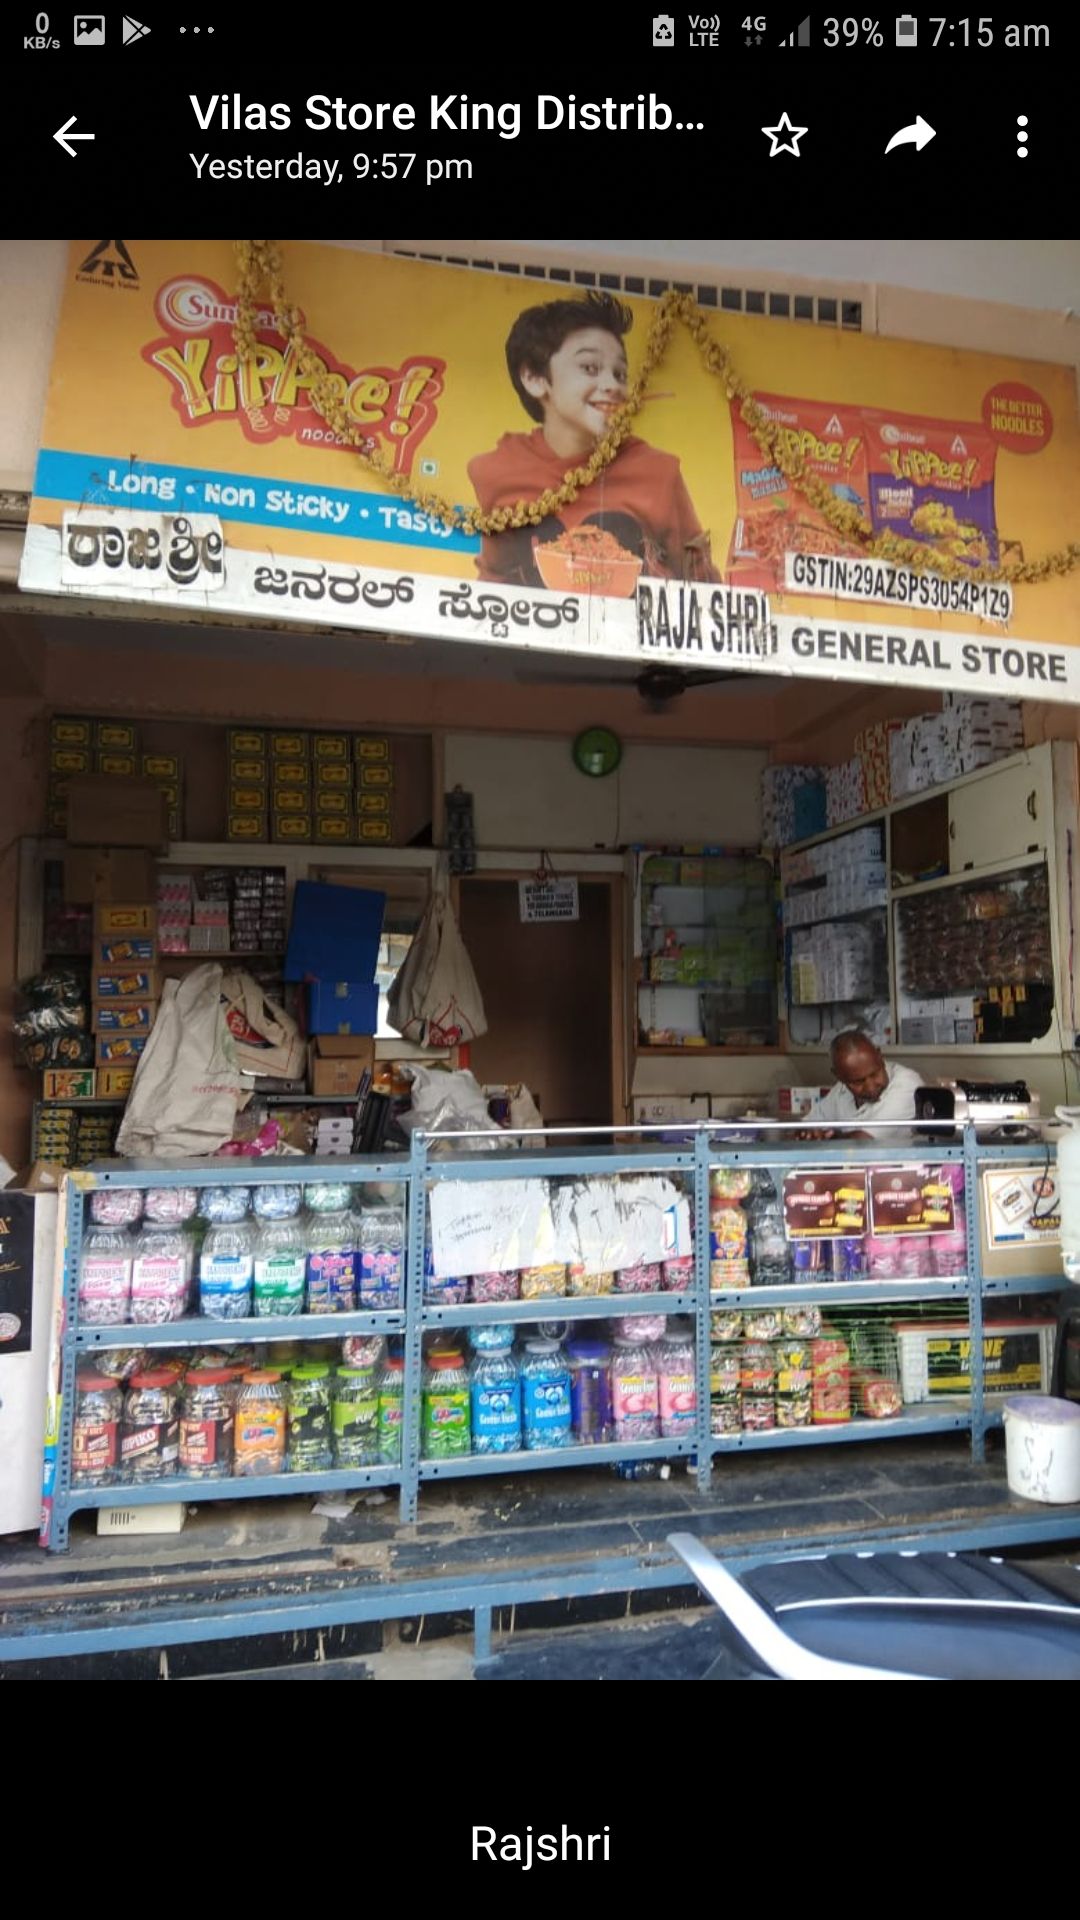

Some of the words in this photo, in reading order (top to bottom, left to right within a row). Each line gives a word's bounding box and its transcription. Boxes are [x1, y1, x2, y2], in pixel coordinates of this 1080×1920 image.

[990, 413, 1045, 437] NOODLES
[1008, 401, 1043, 417] BETTER
[107, 470, 176, 500] Long
[204, 483, 256, 508] Non
[252, 564, 415, 609] ಜನರಲ್
[437, 582, 580, 639] ಸ್ಟೋರ್
[637, 584, 703, 651] RAJA
[790, 626, 952, 670] GENERAL
[961, 643, 1069, 684] STORE
